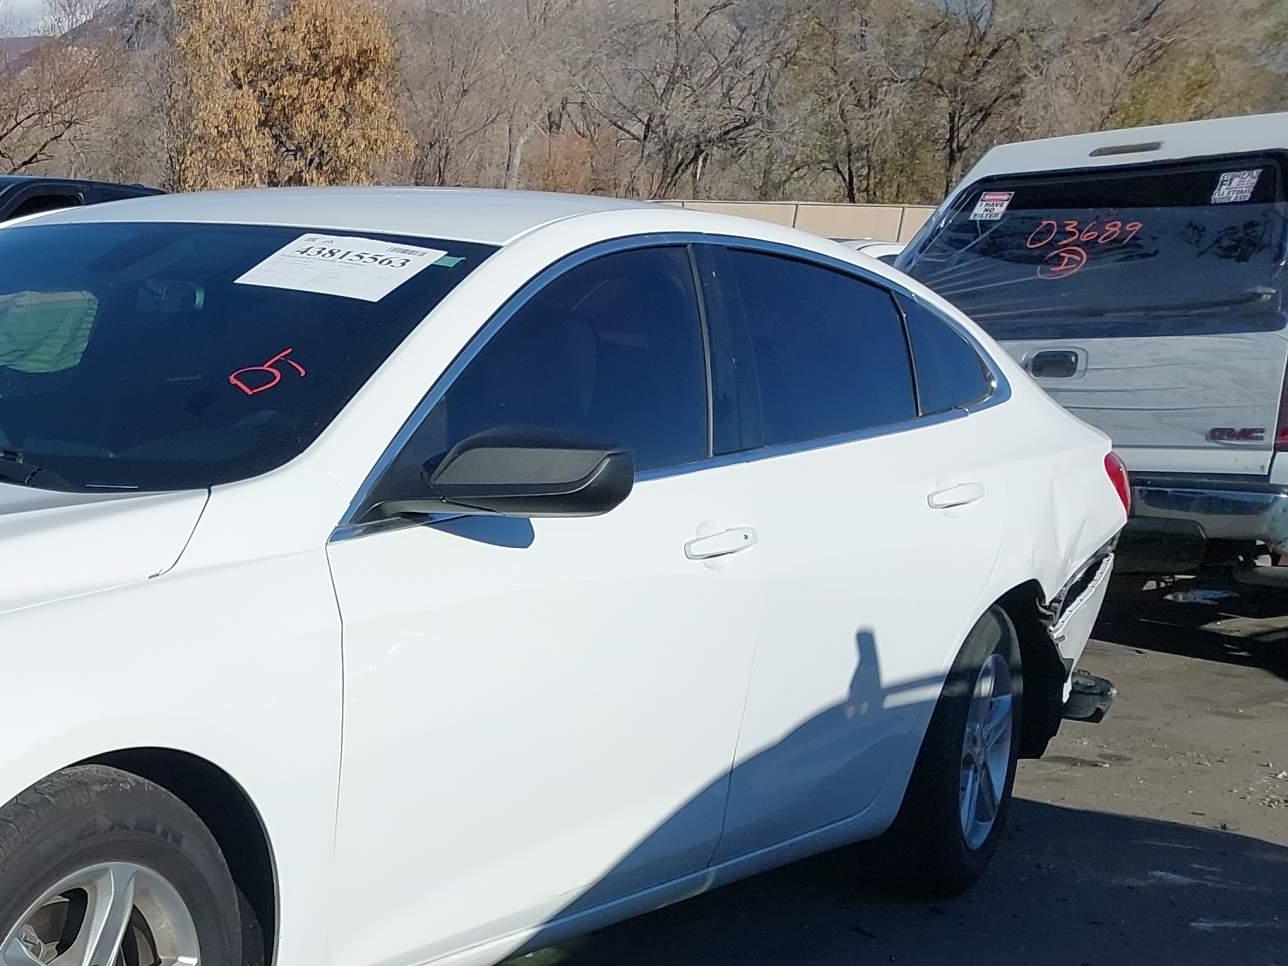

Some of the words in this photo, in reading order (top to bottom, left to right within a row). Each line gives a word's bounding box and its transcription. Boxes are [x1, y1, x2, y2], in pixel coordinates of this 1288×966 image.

[1026, 220, 1143, 249] 03689
[295, 244, 411, 269] 43815563
[1208, 427, 1265, 441] GMC
